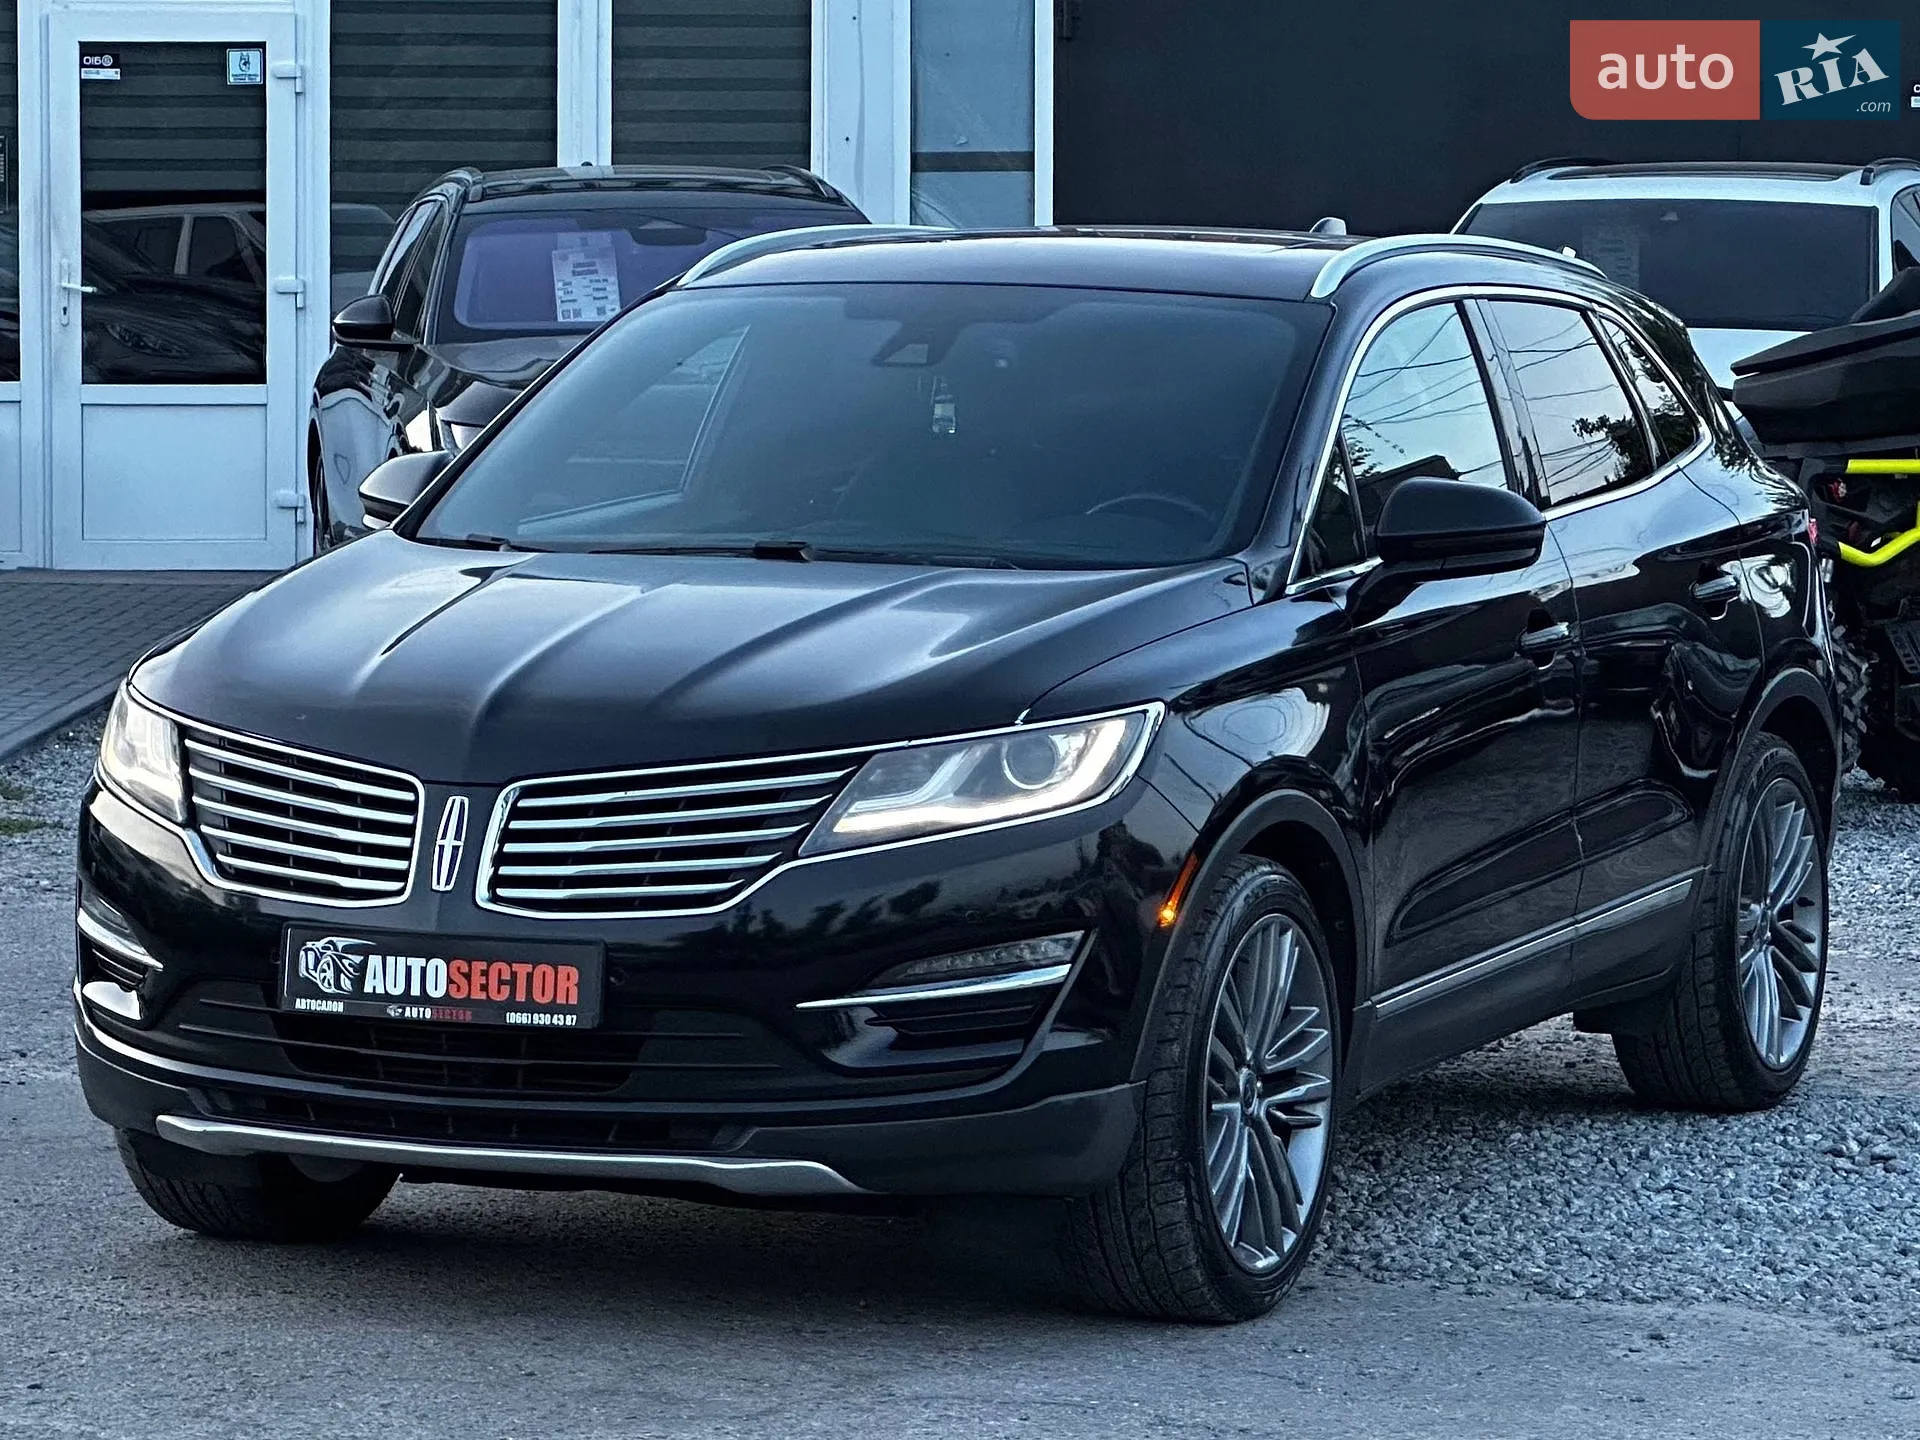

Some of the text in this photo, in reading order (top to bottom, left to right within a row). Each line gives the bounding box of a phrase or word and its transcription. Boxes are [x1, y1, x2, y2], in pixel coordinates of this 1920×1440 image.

[363, 955, 580, 1005] AUTOSECTOR
[506, 1012, 531, 1024] (066)
[532, 1013, 551, 1025] 930
[552, 1014, 564, 1026] 43
